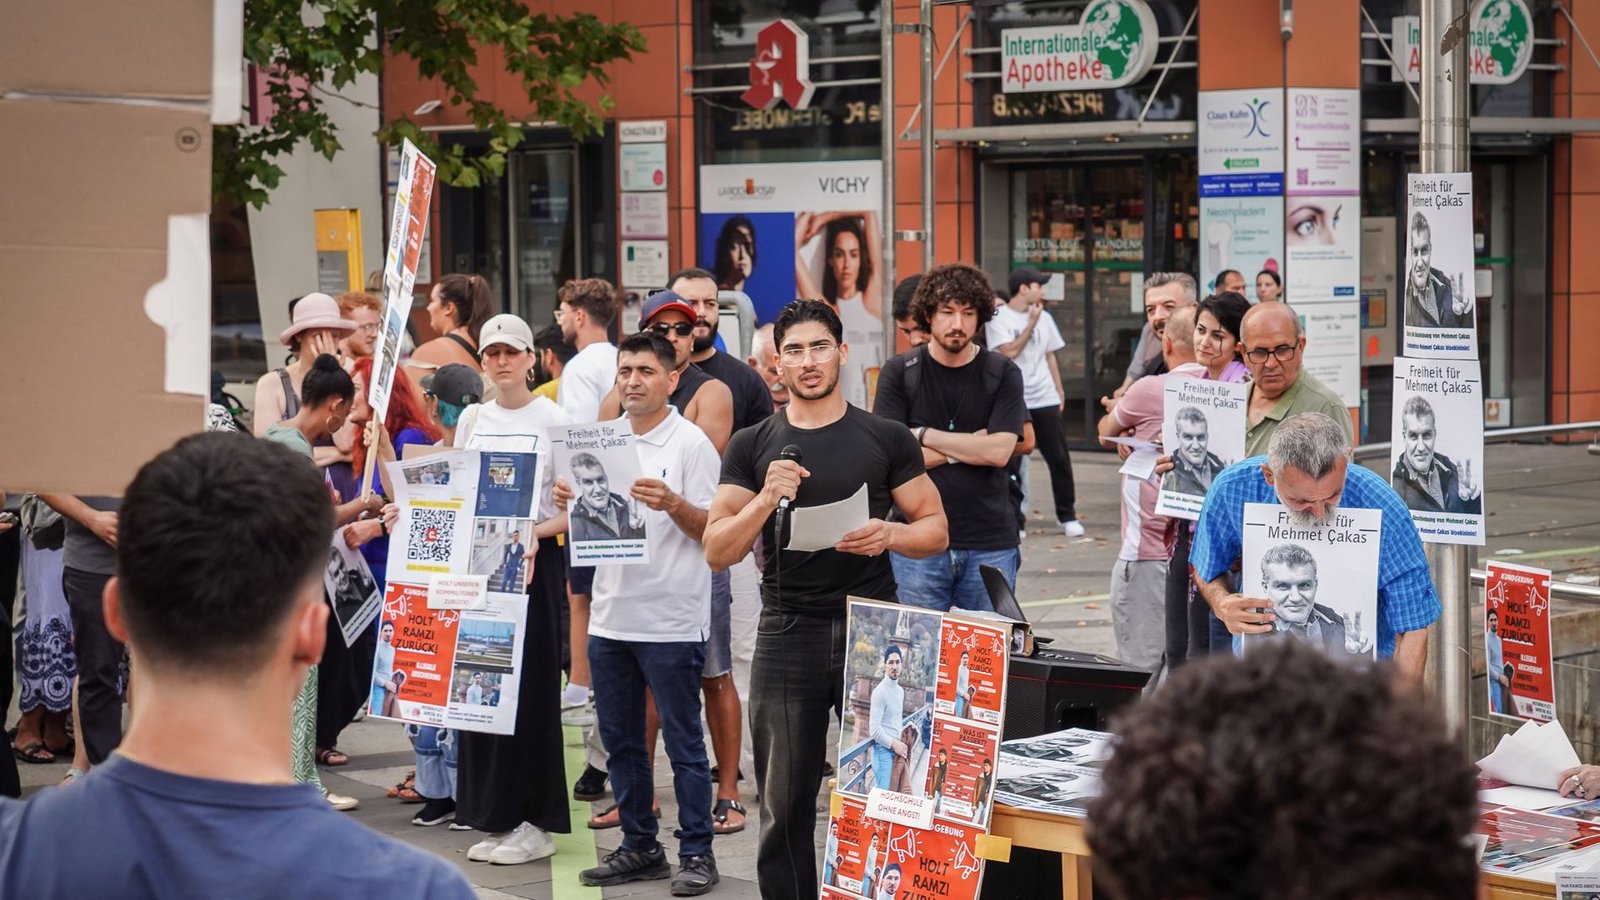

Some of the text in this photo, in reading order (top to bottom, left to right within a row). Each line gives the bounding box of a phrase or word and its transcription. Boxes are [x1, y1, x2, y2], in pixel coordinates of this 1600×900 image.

[1005, 33, 1102, 57] Internationale
[1006, 56, 1103, 88] Apotheke
[1206, 110, 1250, 121] Claus Kuhn
[818, 176, 871, 195] VICHY
[1439, 179, 1454, 193] für
[1435, 193, 1464, 210] Çakas
[1409, 364, 1461, 379] Freiheit für
[1183, 381, 1231, 397] Freiheit für
[1405, 378, 1472, 396] Mehmet Çakas
[1177, 392, 1239, 410] Mehmet Çakas
[567, 426, 615, 440] Freiheit für
[565, 437, 628, 451] Mehmet Çakas
[1335, 514, 1355, 528] für
[1268, 525, 1368, 545] Mehmet Çakas
[452, 581, 481, 589] UNSEREN
[1500, 572, 1535, 585] KUNDGEBUNG
[1506, 601, 1528, 615] HOLT
[407, 613, 435, 627] HOLT
[1504, 614, 1531, 630] RAMZI
[402, 627, 436, 641] RAMZI
[1500, 627, 1536, 645] ZURÜCK!
[394, 638, 439, 655] ZURÜCK!
[976, 645, 992, 656] HOLT
[973, 655, 993, 666] RAMZI
[969, 663, 995, 675] ZURÜCK!
[961, 727, 986, 739] WAS IST
[958, 734, 988, 747] PASSIERT?
[879, 791, 924, 808] HOCHSCHULE
[877, 803, 898, 816] OHNE
[897, 806, 921, 820] ANGST!
[844, 818, 859, 827] HOLT
[841, 825, 860, 836] RAMZI
[919, 856, 950, 877] HOLT
[912, 873, 951, 897] RAMZI
